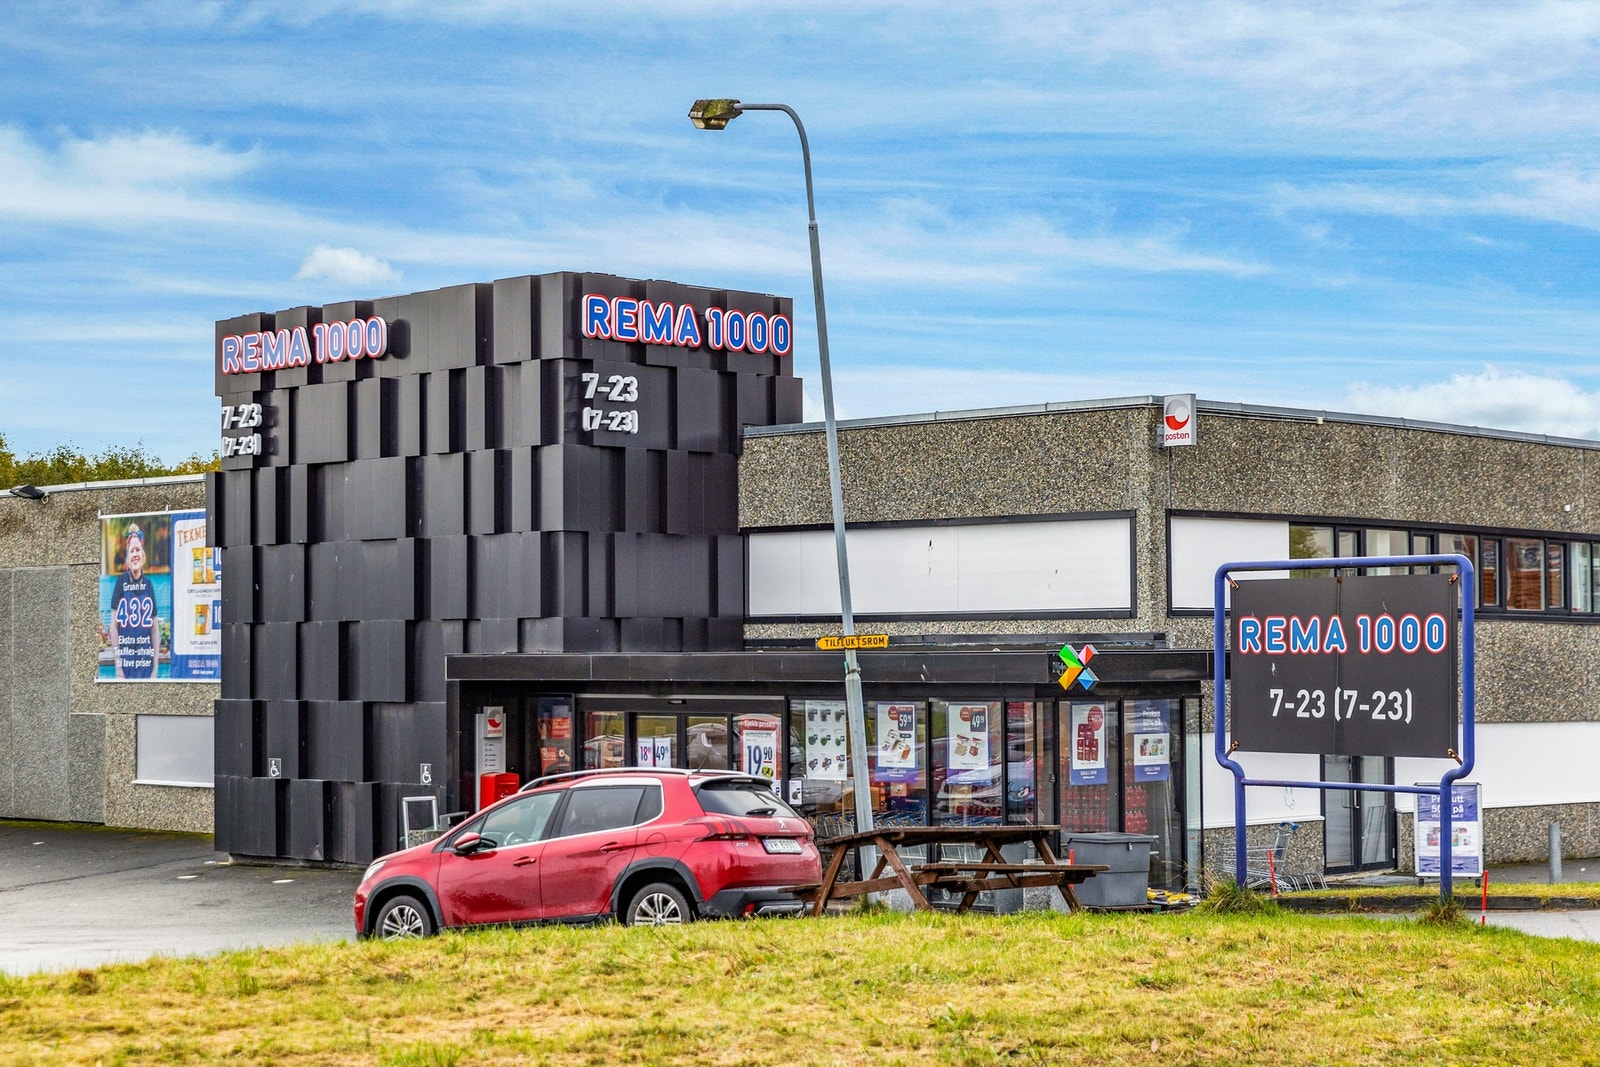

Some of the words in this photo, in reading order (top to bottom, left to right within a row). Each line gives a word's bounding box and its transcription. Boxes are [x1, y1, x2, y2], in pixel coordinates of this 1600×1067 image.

[582, 293, 702, 348] REMA
[705, 306, 792, 356] 1000
[222, 326, 311, 375] REMA
[313, 316, 387, 364] 1000
[582, 373, 639, 403] 7-23
[222, 403, 262, 429] 7-23
[582, 406, 639, 434] (7-23)
[221, 433, 262, 457] (7-23)
[1165, 432, 1190, 442] posten
[116, 597, 153, 627] 432
[118, 635, 135, 644] Ekstra
[136, 636, 150, 644] stort
[824, 637, 885, 647] TILFLUKTSROM
[1238, 614, 1348, 655] REMA
[1356, 612, 1449, 655] 1000
[123, 658, 134, 667] lave
[135, 658, 152, 668] priser
[1269, 688, 1326, 718] 7-23
[1334, 686, 1413, 724] (7-23)
